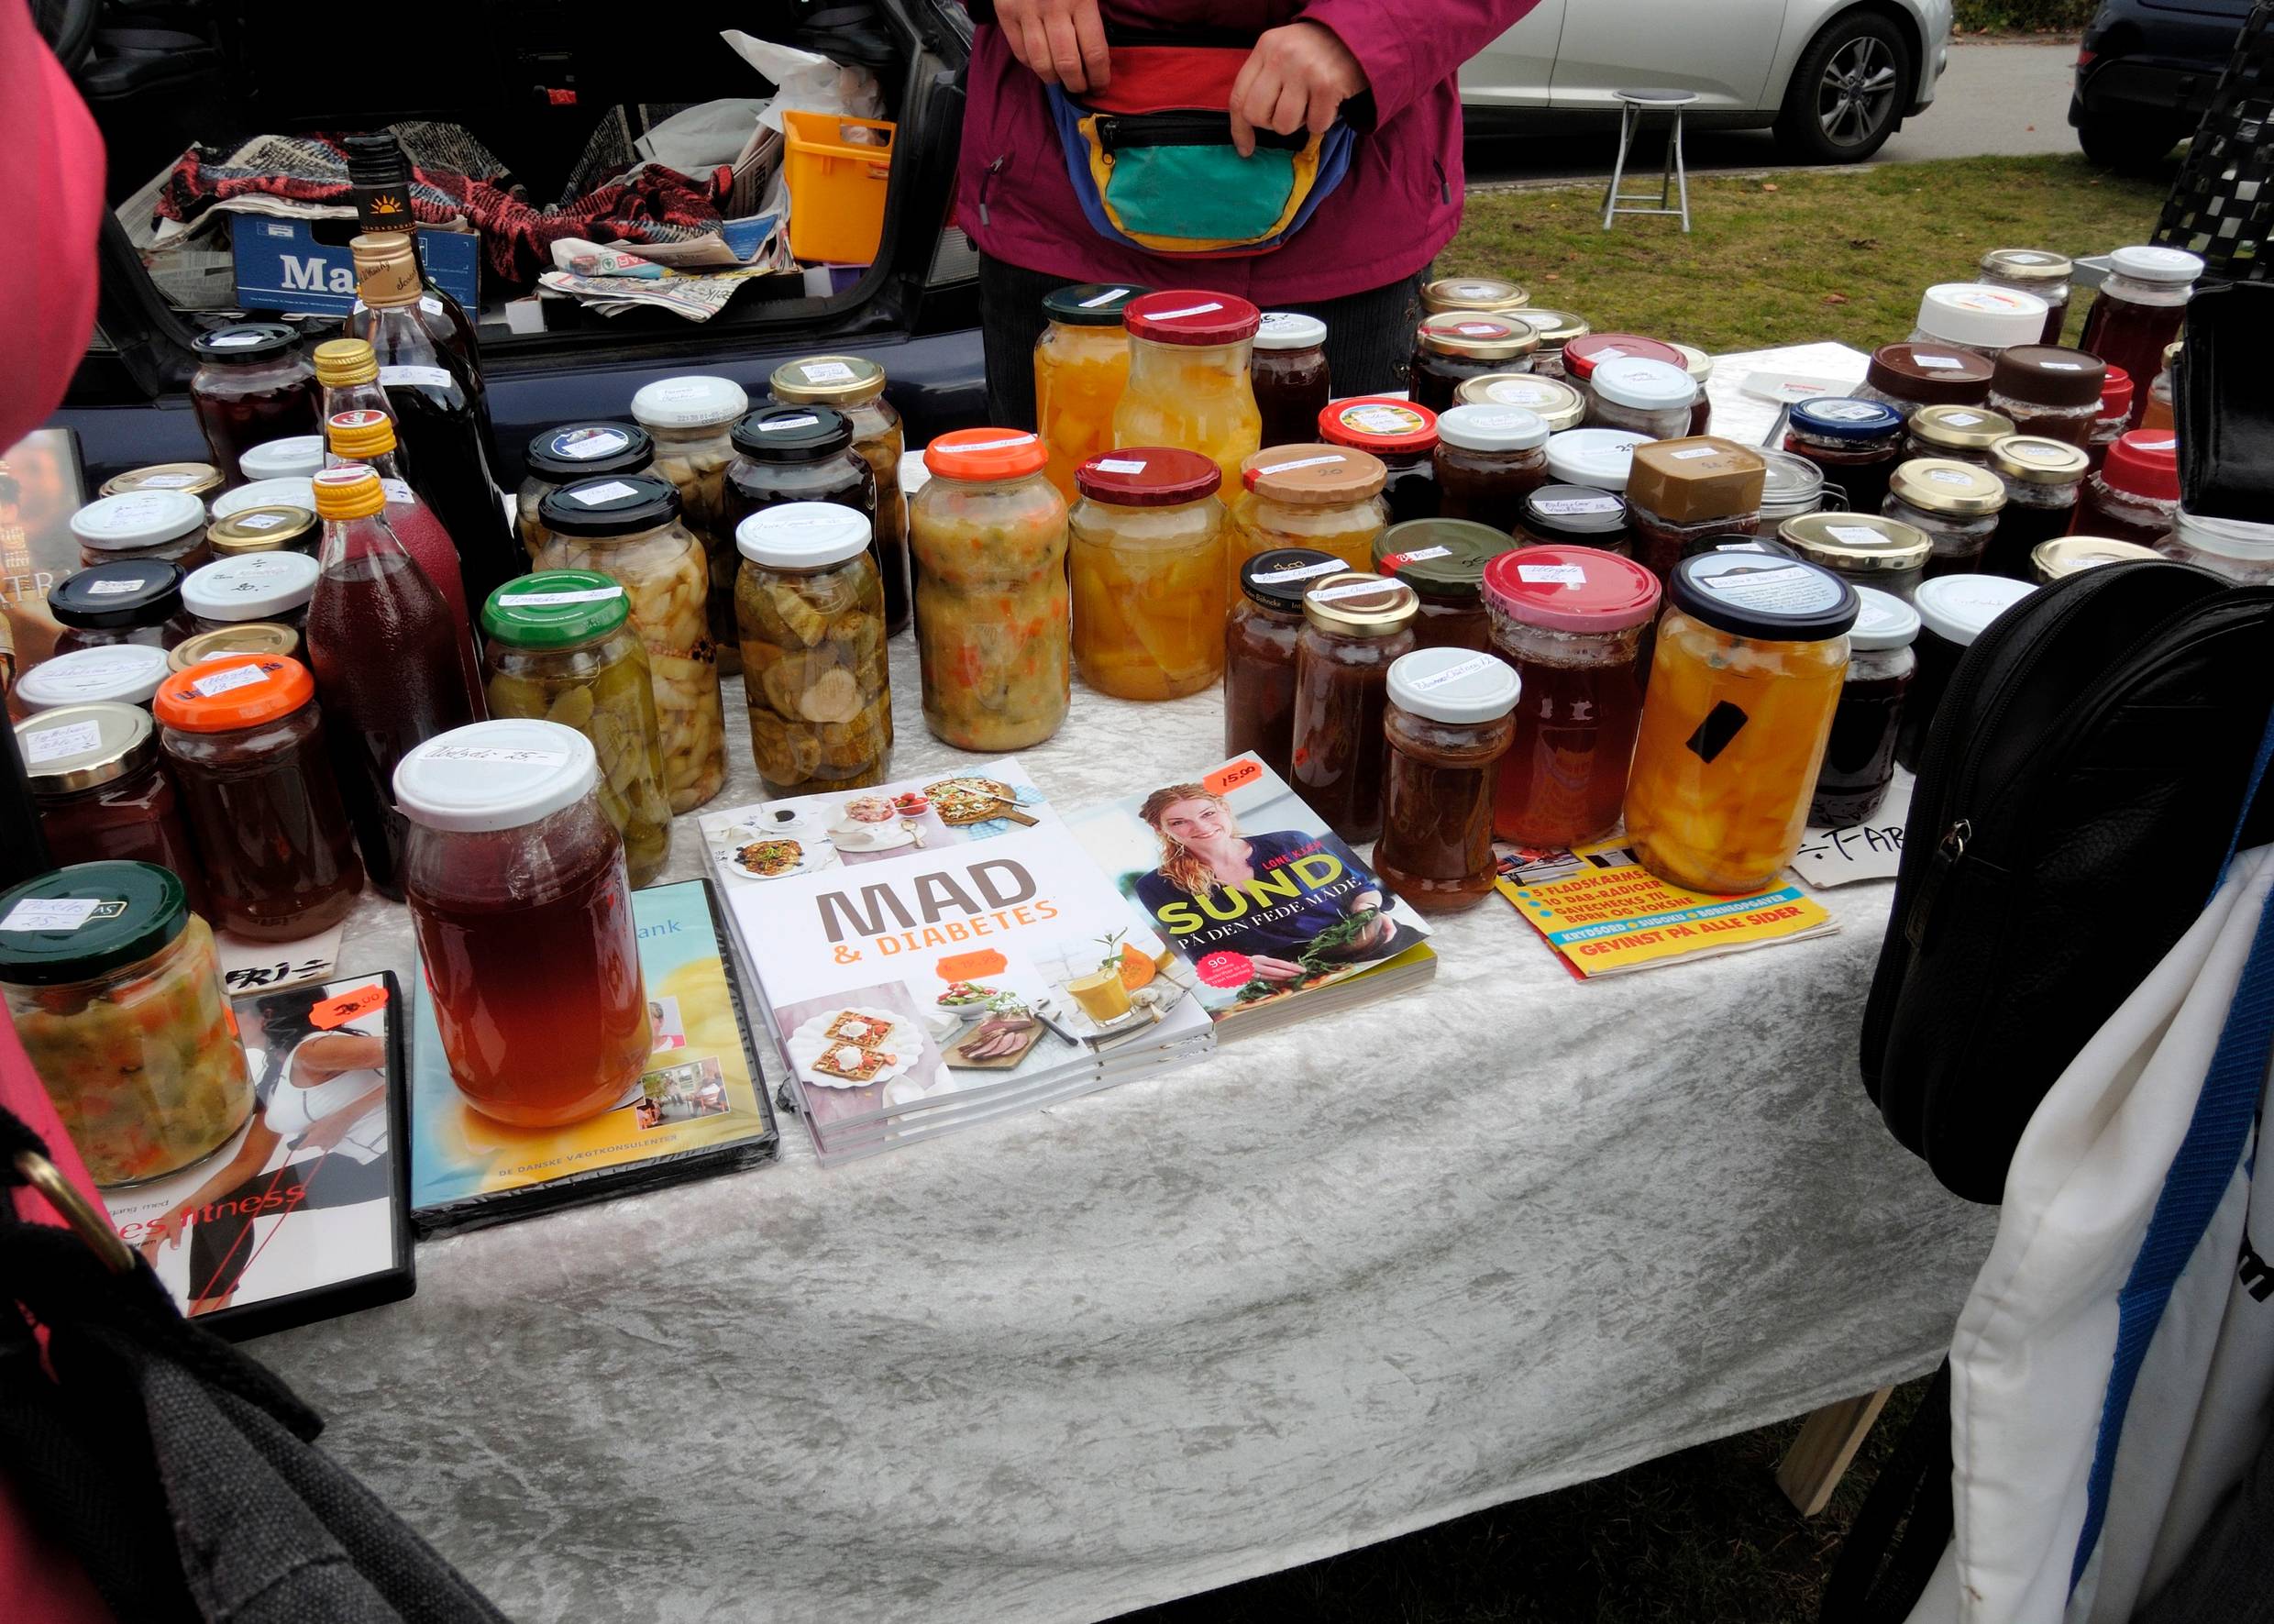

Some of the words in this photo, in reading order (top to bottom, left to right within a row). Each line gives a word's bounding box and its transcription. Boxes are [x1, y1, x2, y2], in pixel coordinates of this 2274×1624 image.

[1222, 765, 1256, 788] 15.00
[1262, 856, 1291, 871] LONE
[816, 858, 1037, 943] MAD
[1157, 854, 1343, 934] SUND
[1532, 889, 1544, 898] 5
[1542, 897, 1561, 907] 10
[1564, 879, 1663, 903] DAB-RADIOER
[1553, 895, 1646, 916] GAVECHECKS
[1650, 890, 1671, 901] TIL
[1207, 921, 1252, 942] DEN
[1251, 901, 1306, 927] FEDE
[1561, 922, 1628, 943] KRYDSORD
[1637, 913, 1687, 928] SUDOKU
[1696, 893, 1788, 918] BØRNEOPGAVER
[1564, 911, 1609, 924] BØRN
[1611, 907, 1635, 917] OG
[1635, 896, 1695, 913] VOKSNE
[833, 945, 863, 965] &
[875, 900, 1058, 956] DIABETES
[1578, 930, 1668, 957] GEVINST
[1670, 923, 1698, 939] PÅ
[1700, 917, 1747, 934] ALLE
[1745, 905, 1805, 926] SIDER
[1208, 956, 1227, 968] 90
[498, 1168, 513, 1177] DE
[517, 1157, 563, 1173] DANSKE
[181, 1184, 307, 1228] fitness
